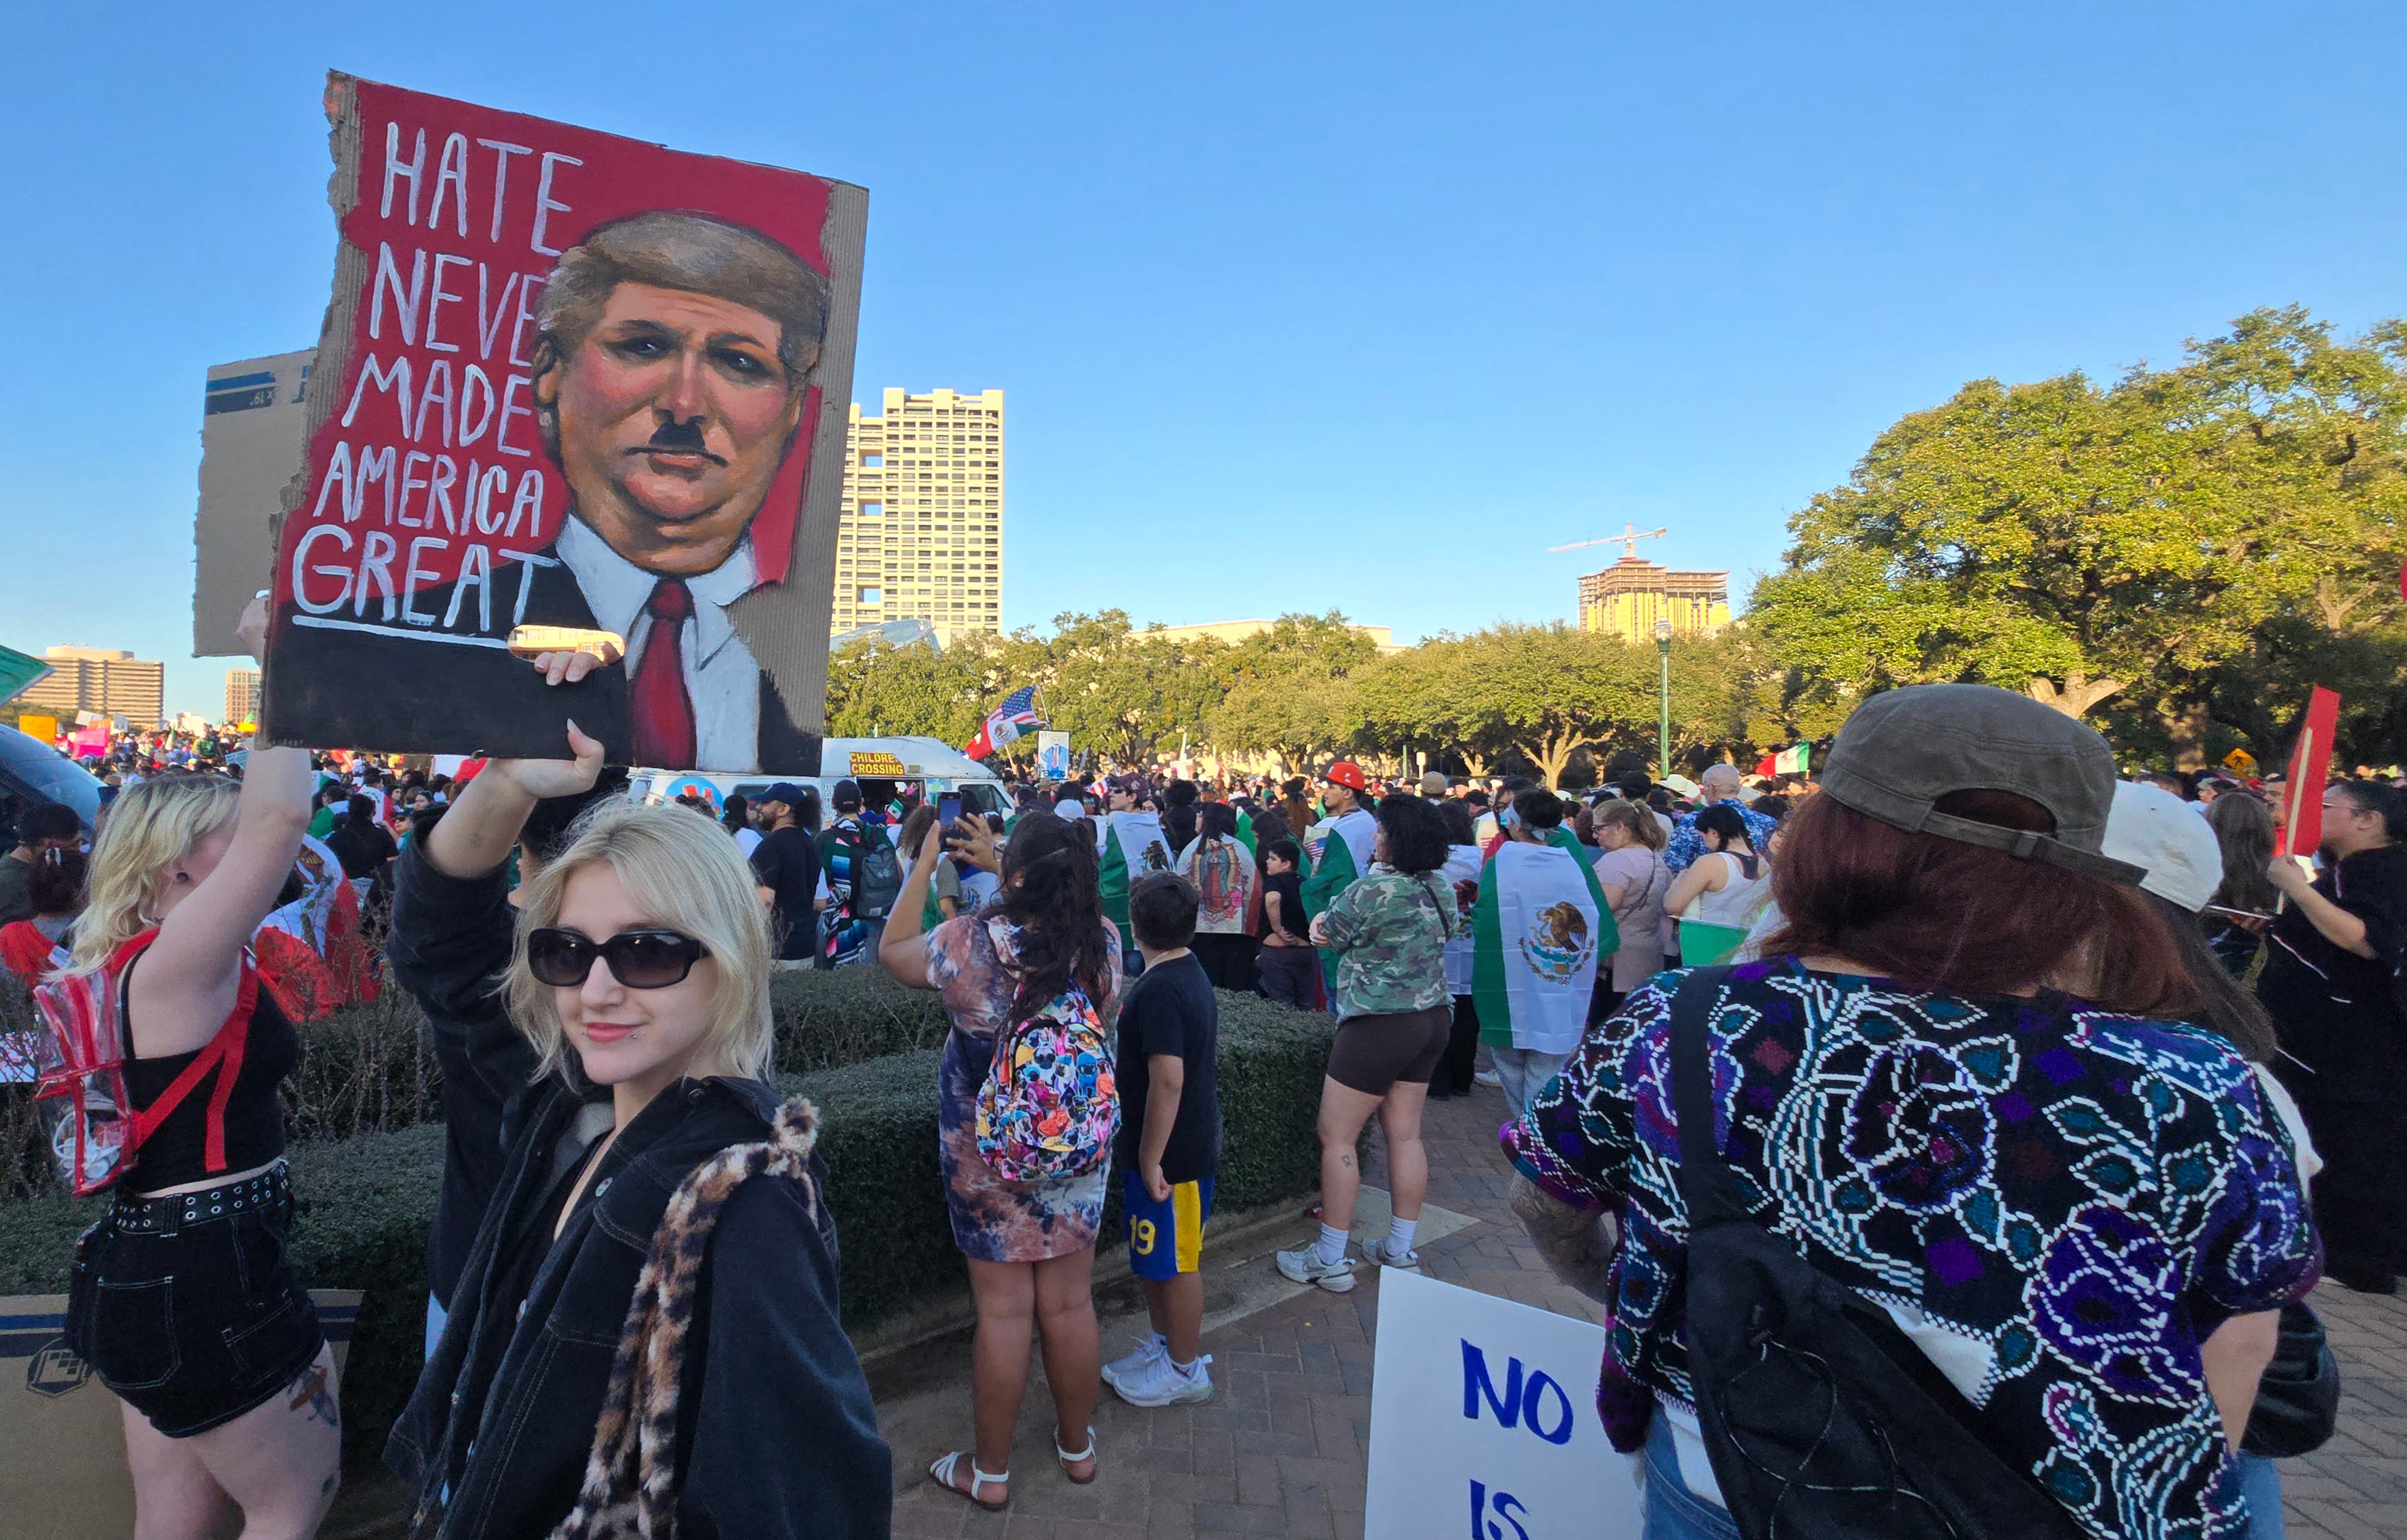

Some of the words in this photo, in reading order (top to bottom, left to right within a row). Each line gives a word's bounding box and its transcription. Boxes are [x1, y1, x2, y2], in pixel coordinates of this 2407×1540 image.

[380, 122, 584, 257] HATE
[341, 353, 533, 457] MADE
[313, 441, 544, 537] AMERICA
[292, 525, 559, 633] GREAT
[850, 753, 899, 763] CHILDRE
[851, 764, 903, 774] CROSSING
[1130, 1214, 1156, 1255] 19
[1461, 1338, 1573, 1445] NO
[1470, 1478, 1530, 1540] IS
